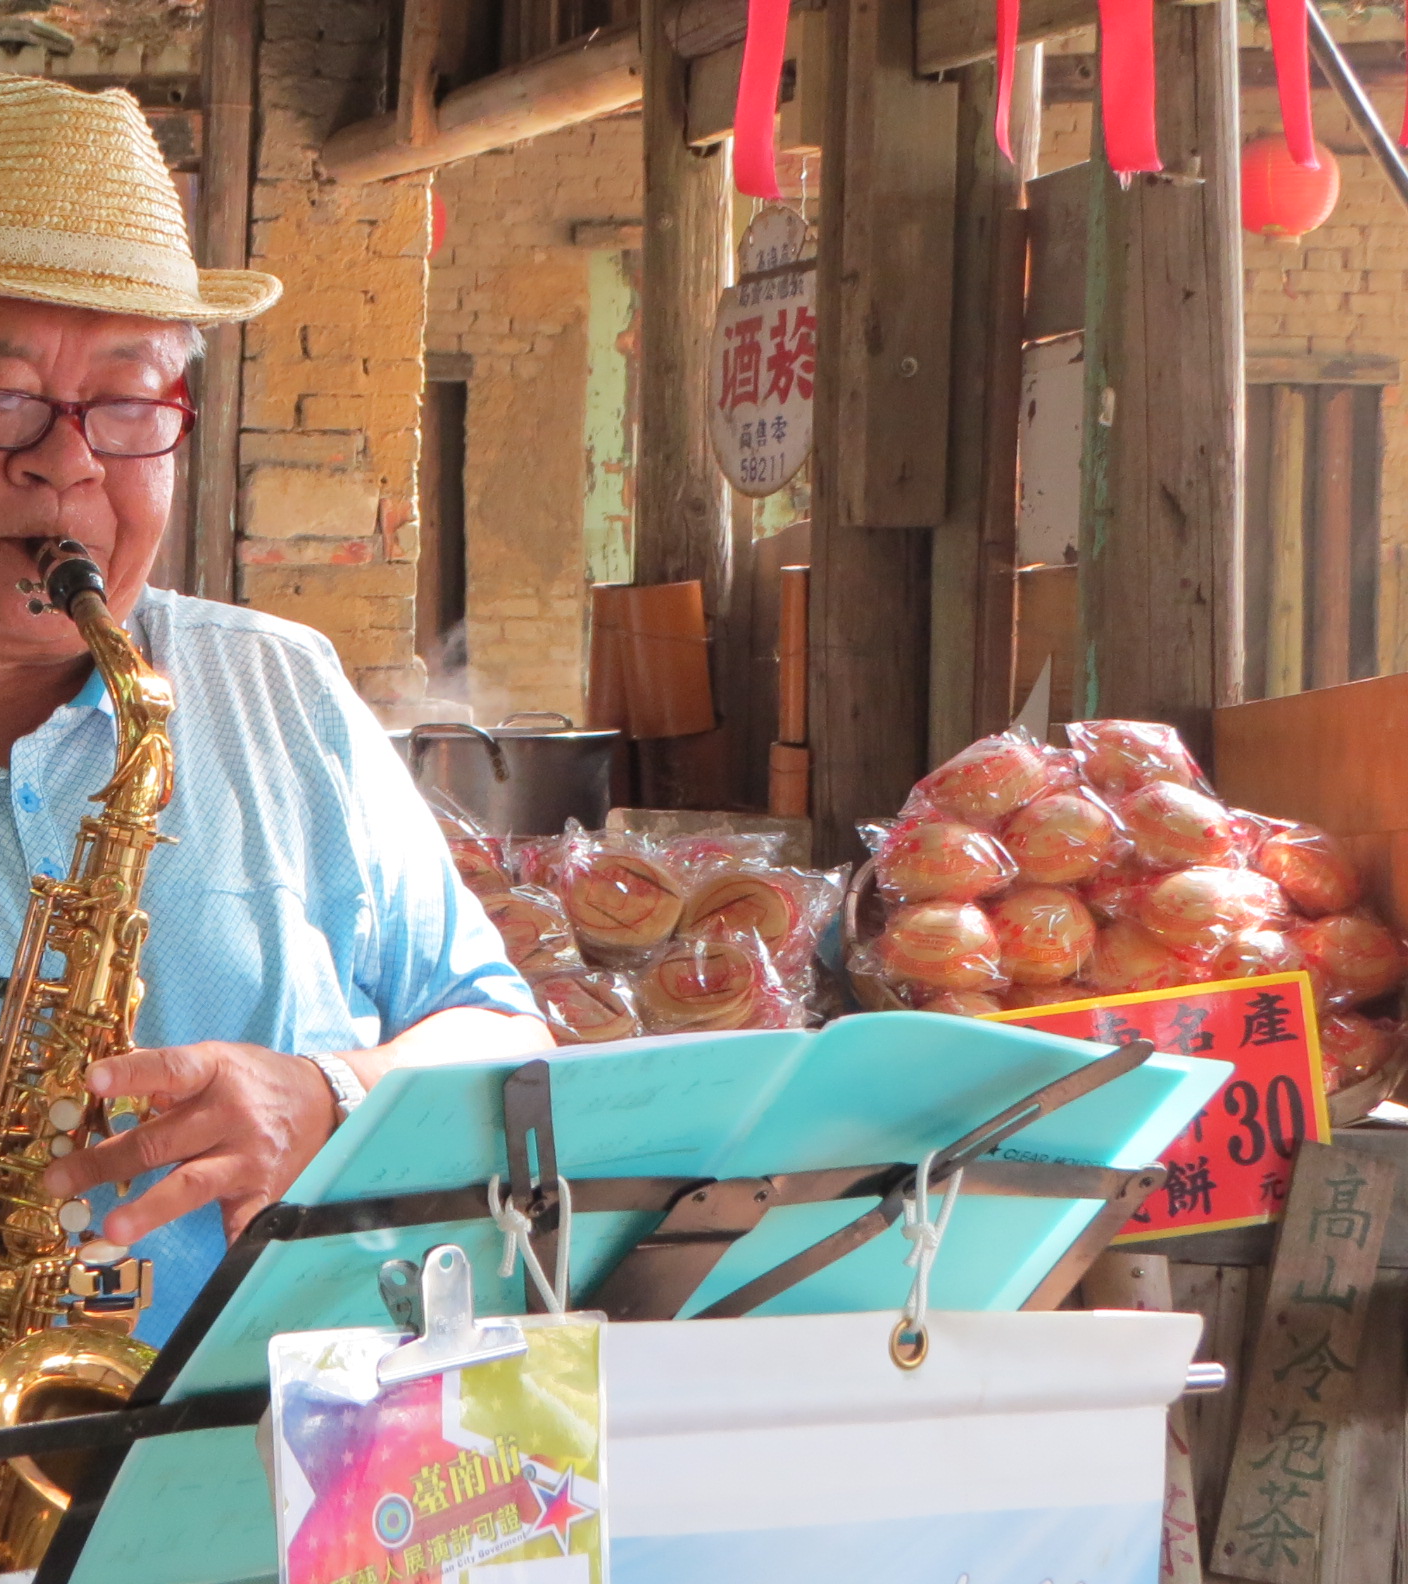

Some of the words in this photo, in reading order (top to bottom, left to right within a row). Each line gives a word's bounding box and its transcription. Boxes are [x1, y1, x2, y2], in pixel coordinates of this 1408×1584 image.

[739, 451, 786, 484] 58211
[1224, 1074, 1306, 1166] 30
[410, 1434, 523, 1518] 臺南市
